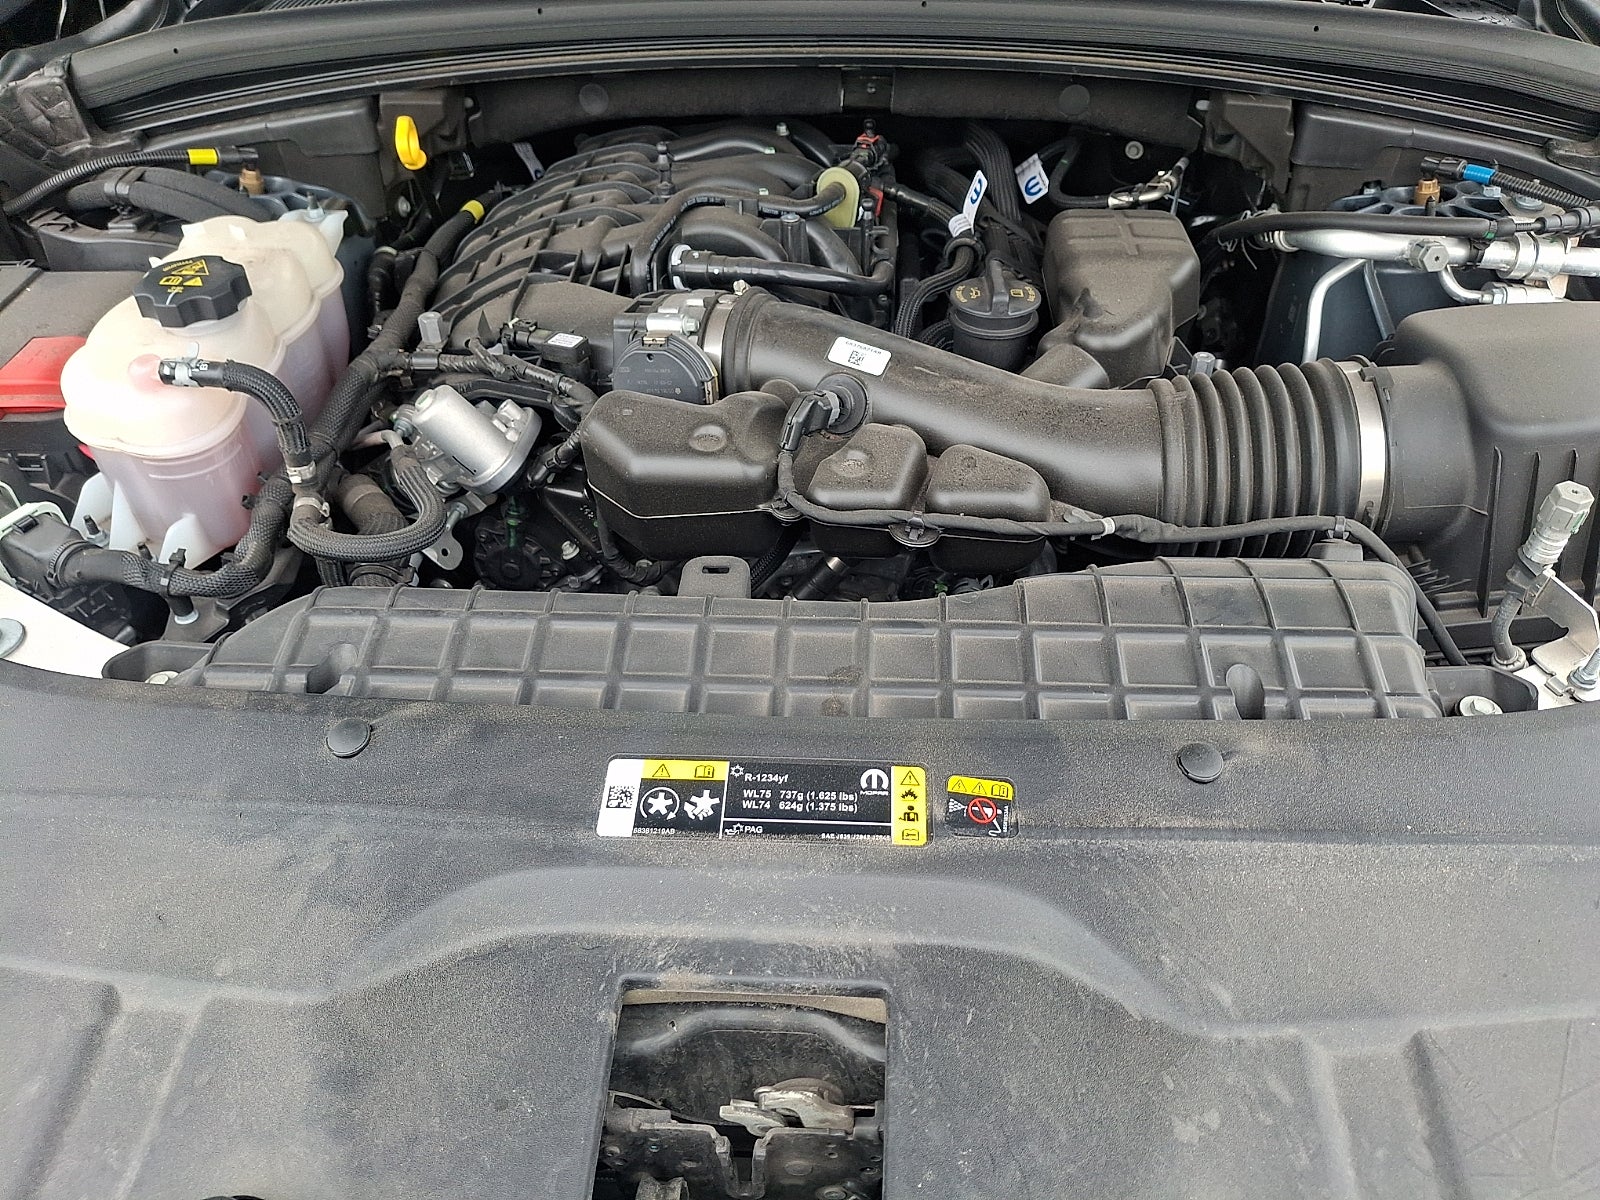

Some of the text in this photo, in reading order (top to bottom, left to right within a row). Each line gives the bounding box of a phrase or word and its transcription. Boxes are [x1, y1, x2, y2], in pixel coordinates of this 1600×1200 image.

[744, 772, 789, 784] R-1234yf
[743, 789, 858, 803] WL75 737g (1.625 lbs)
[742, 799, 858, 814] WL74 624g (1.375 lbs)
[744, 825, 763, 834] PAG
